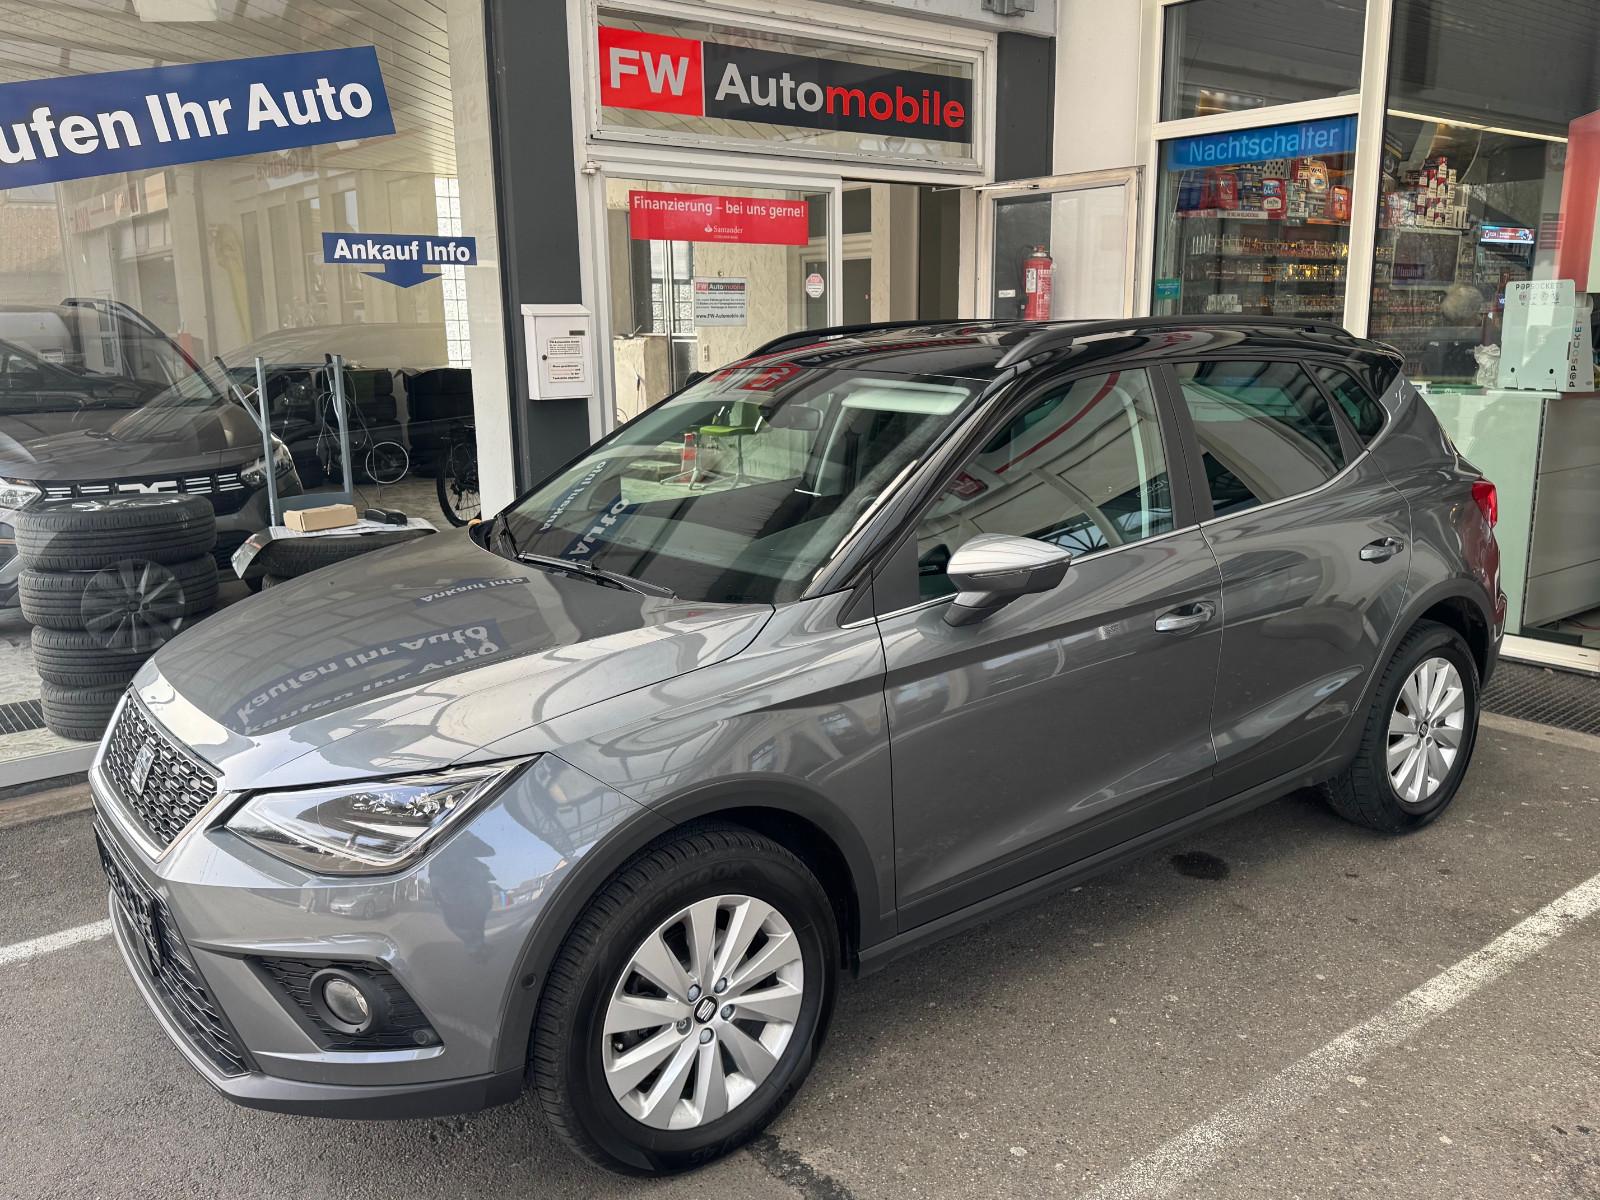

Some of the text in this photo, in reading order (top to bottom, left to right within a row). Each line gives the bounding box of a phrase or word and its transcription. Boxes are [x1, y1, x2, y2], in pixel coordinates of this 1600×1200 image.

[609, 46, 965, 128] FW Automobile
[145, 92, 232, 143] Ihr
[247, 77, 372, 132] Auto
[1189, 126, 1339, 163] Nachtschalter
[634, 195, 713, 216] Finanzierung
[725, 201, 743, 214] bei
[746, 205, 766, 216] uns
[769, 205, 804, 219] gerne!
[713, 225, 744, 235] Santander
[333, 238, 471, 262] Ankauf Info
